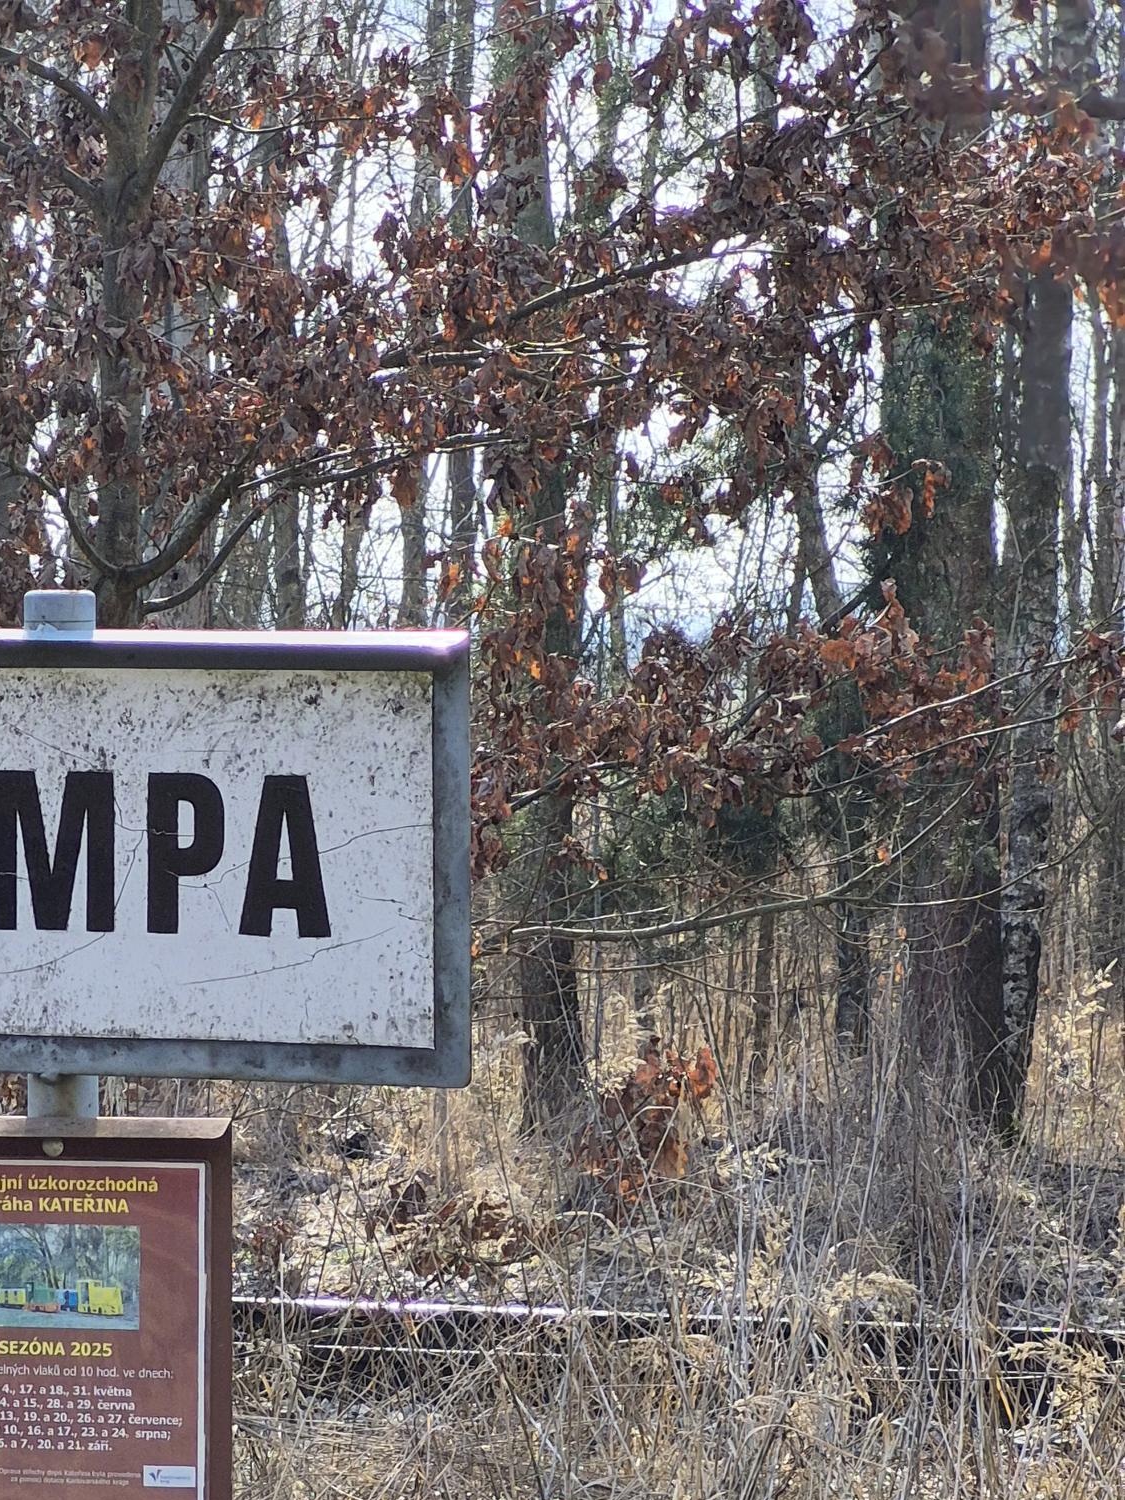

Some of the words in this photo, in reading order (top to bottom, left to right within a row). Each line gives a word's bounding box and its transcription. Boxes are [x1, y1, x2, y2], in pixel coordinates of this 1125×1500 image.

[28, 1174, 159, 1193] úzkorozchodná
[38, 1194, 129, 1214] KATEŘINA
[70, 1342, 113, 1357] 2025
[33, 1364, 60, 1376] vlaků
[63, 1366, 77, 1376] od
[81, 1366, 93, 1377] 10
[96, 1366, 119, 1377] hod.
[123, 1369, 135, 1377] ve
[138, 1368, 174, 1379] dnech:
[1, 1384, 16, 1395] 4.,
[19, 1384, 36, 1394] 17.
[39, 1386, 46, 1394] a
[49, 1385, 70, 1397] 18.,
[73, 1386, 90, 1395] 31.
[94, 1386, 132, 1397] května
[13, 1399, 20, 1408] a
[23, 1398, 43, 1410] 15.,
[46, 1398, 64, 1409] 28.
[66, 1400, 74, 1409] a
[77, 1400, 94, 1409] 29.
[97, 1399, 135, 1410] června
[0, 1411, 20, 1422] 13.,
[23, 1411, 40, 1421] 19.
[43, 1413, 50, 1422] a
[53, 1412, 74, 1424] 20.,
[77, 1413, 94, 1423] 26.
[97, 1415, 104, 1423] a
[107, 1414, 125, 1424] 27.
[128, 1413, 183, 1427] července;
[4, 1425, 23, 1436] 10.,
[27, 1426, 44, 1435] 16.
[47, 1427, 54, 1435] a
[57, 1426, 77, 1438] 17.,
[81, 1427, 98, 1437] 23.
[101, 1429, 108, 1437] a
[135, 1430, 171, 1440] srpna;
[10, 1440, 17, 1448] a
[20, 1439, 34, 1450] 7.,
[37, 1440, 55, 1449] 20.
[57, 1442, 64, 1450] a
[67, 1440, 85, 1450] 21.
[87, 1440, 112, 1451] září.
